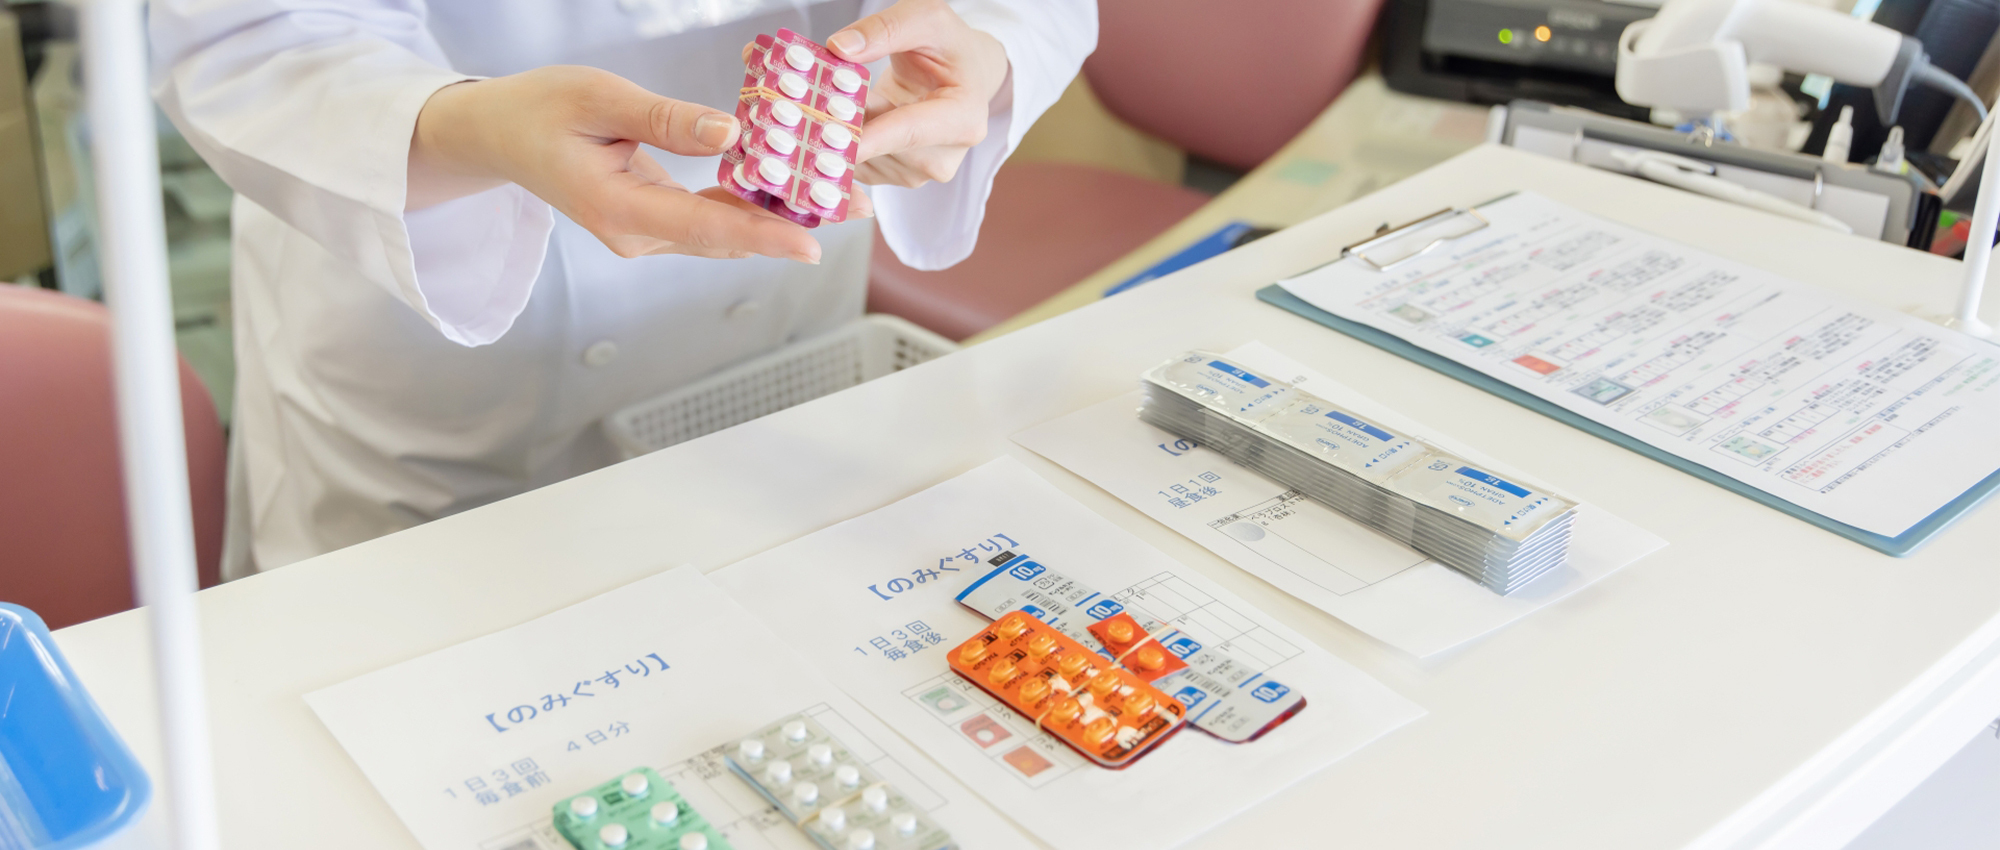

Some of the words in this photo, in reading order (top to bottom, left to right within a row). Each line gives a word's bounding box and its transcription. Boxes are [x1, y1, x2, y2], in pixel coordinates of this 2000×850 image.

[867, 533, 1020, 601] 【のみぐすり】
[883, 631, 948, 662] 毎食後
[484, 652, 672, 733] 【のみぐすり】
[475, 769, 552, 807] 毎食前
